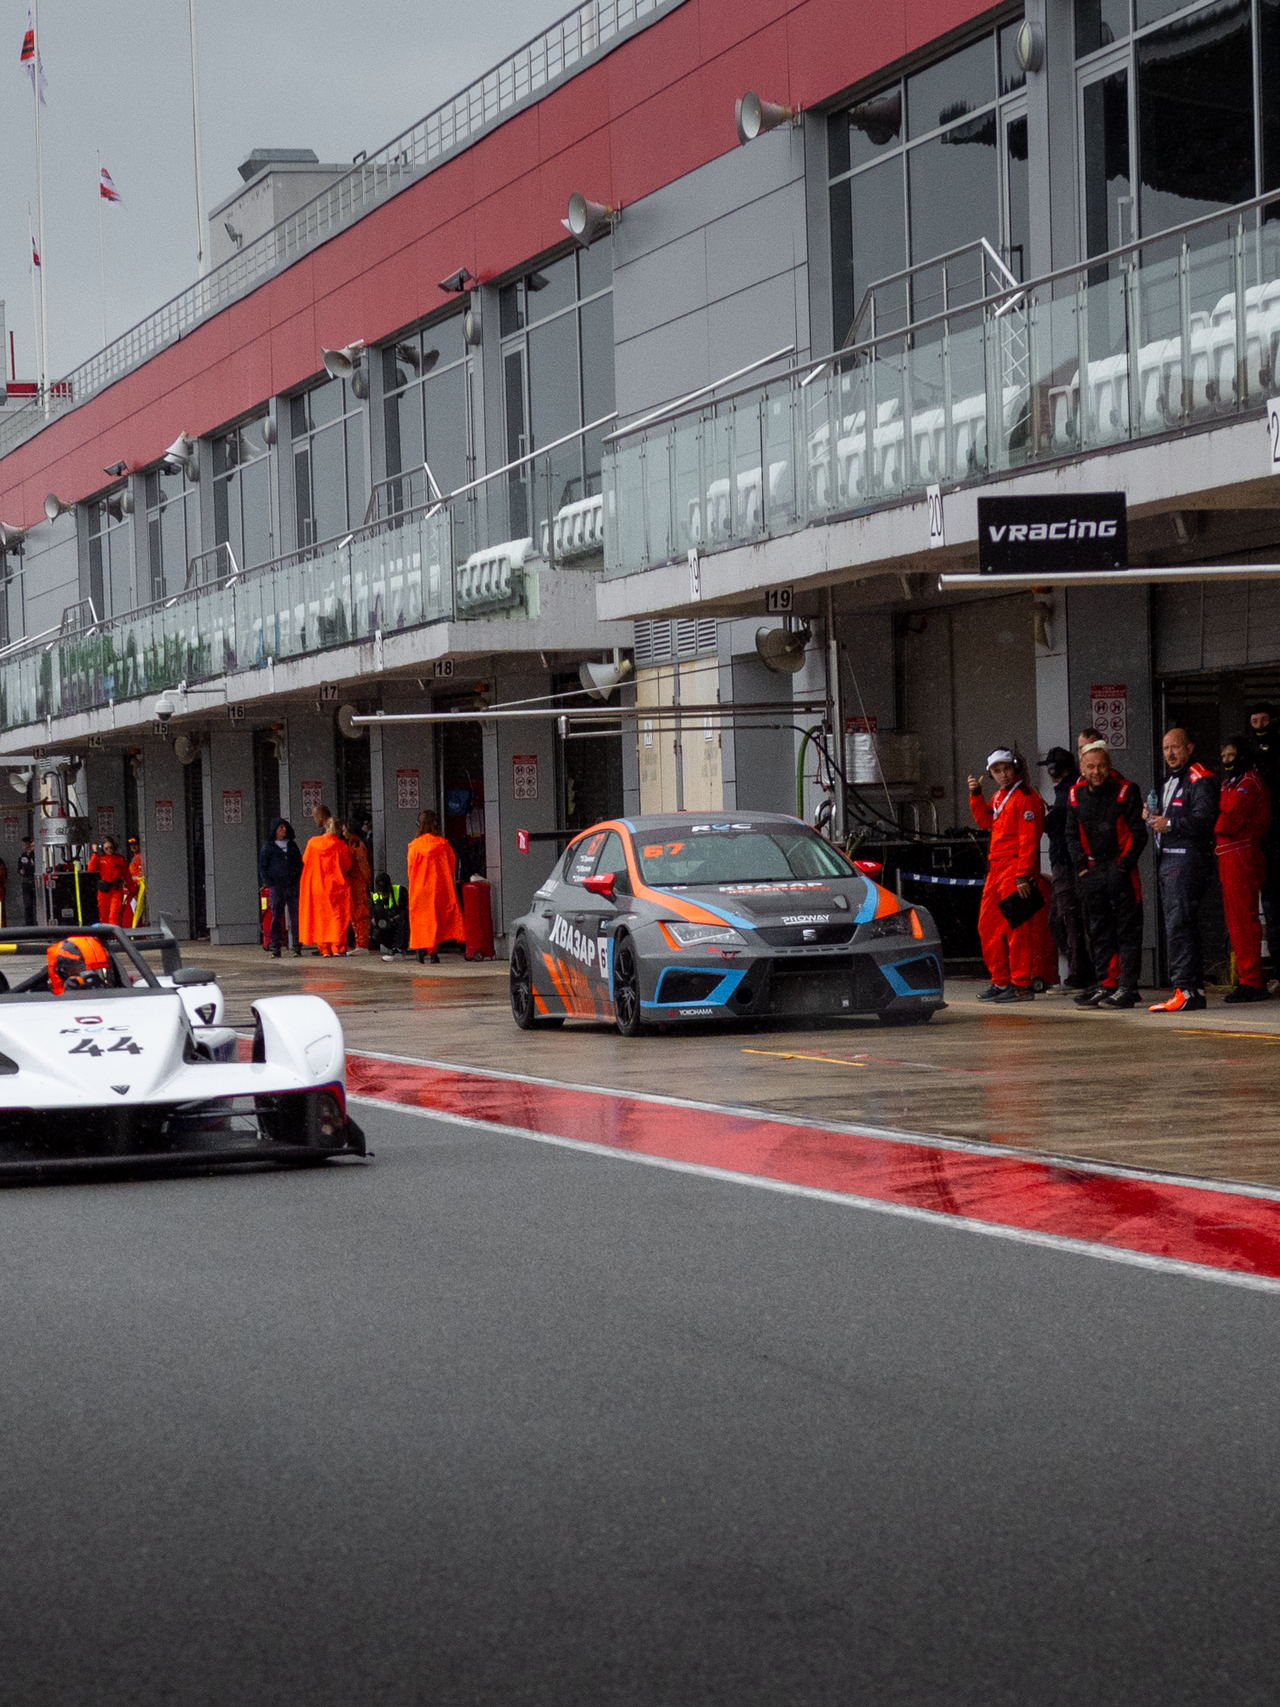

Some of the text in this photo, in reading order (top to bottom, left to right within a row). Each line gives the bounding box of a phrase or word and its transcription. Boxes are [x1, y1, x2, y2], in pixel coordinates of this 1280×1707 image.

[929, 493, 942, 538] 20
[770, 589, 791, 609] 19
[436, 660, 453, 676] 18
[323, 685, 337, 699] 17
[231, 706, 244, 717] 16
[155, 723, 167, 733] 15
[90, 736, 101, 746] 14
[36, 748, 46, 757] 13
[643, 842, 685, 859] 67
[781, 914, 830, 925] PROWAY
[549, 914, 596, 967] КВАЗАР
[679, 1008, 713, 1016] YOKOHAMA
[68, 1036, 144, 1057] 44
